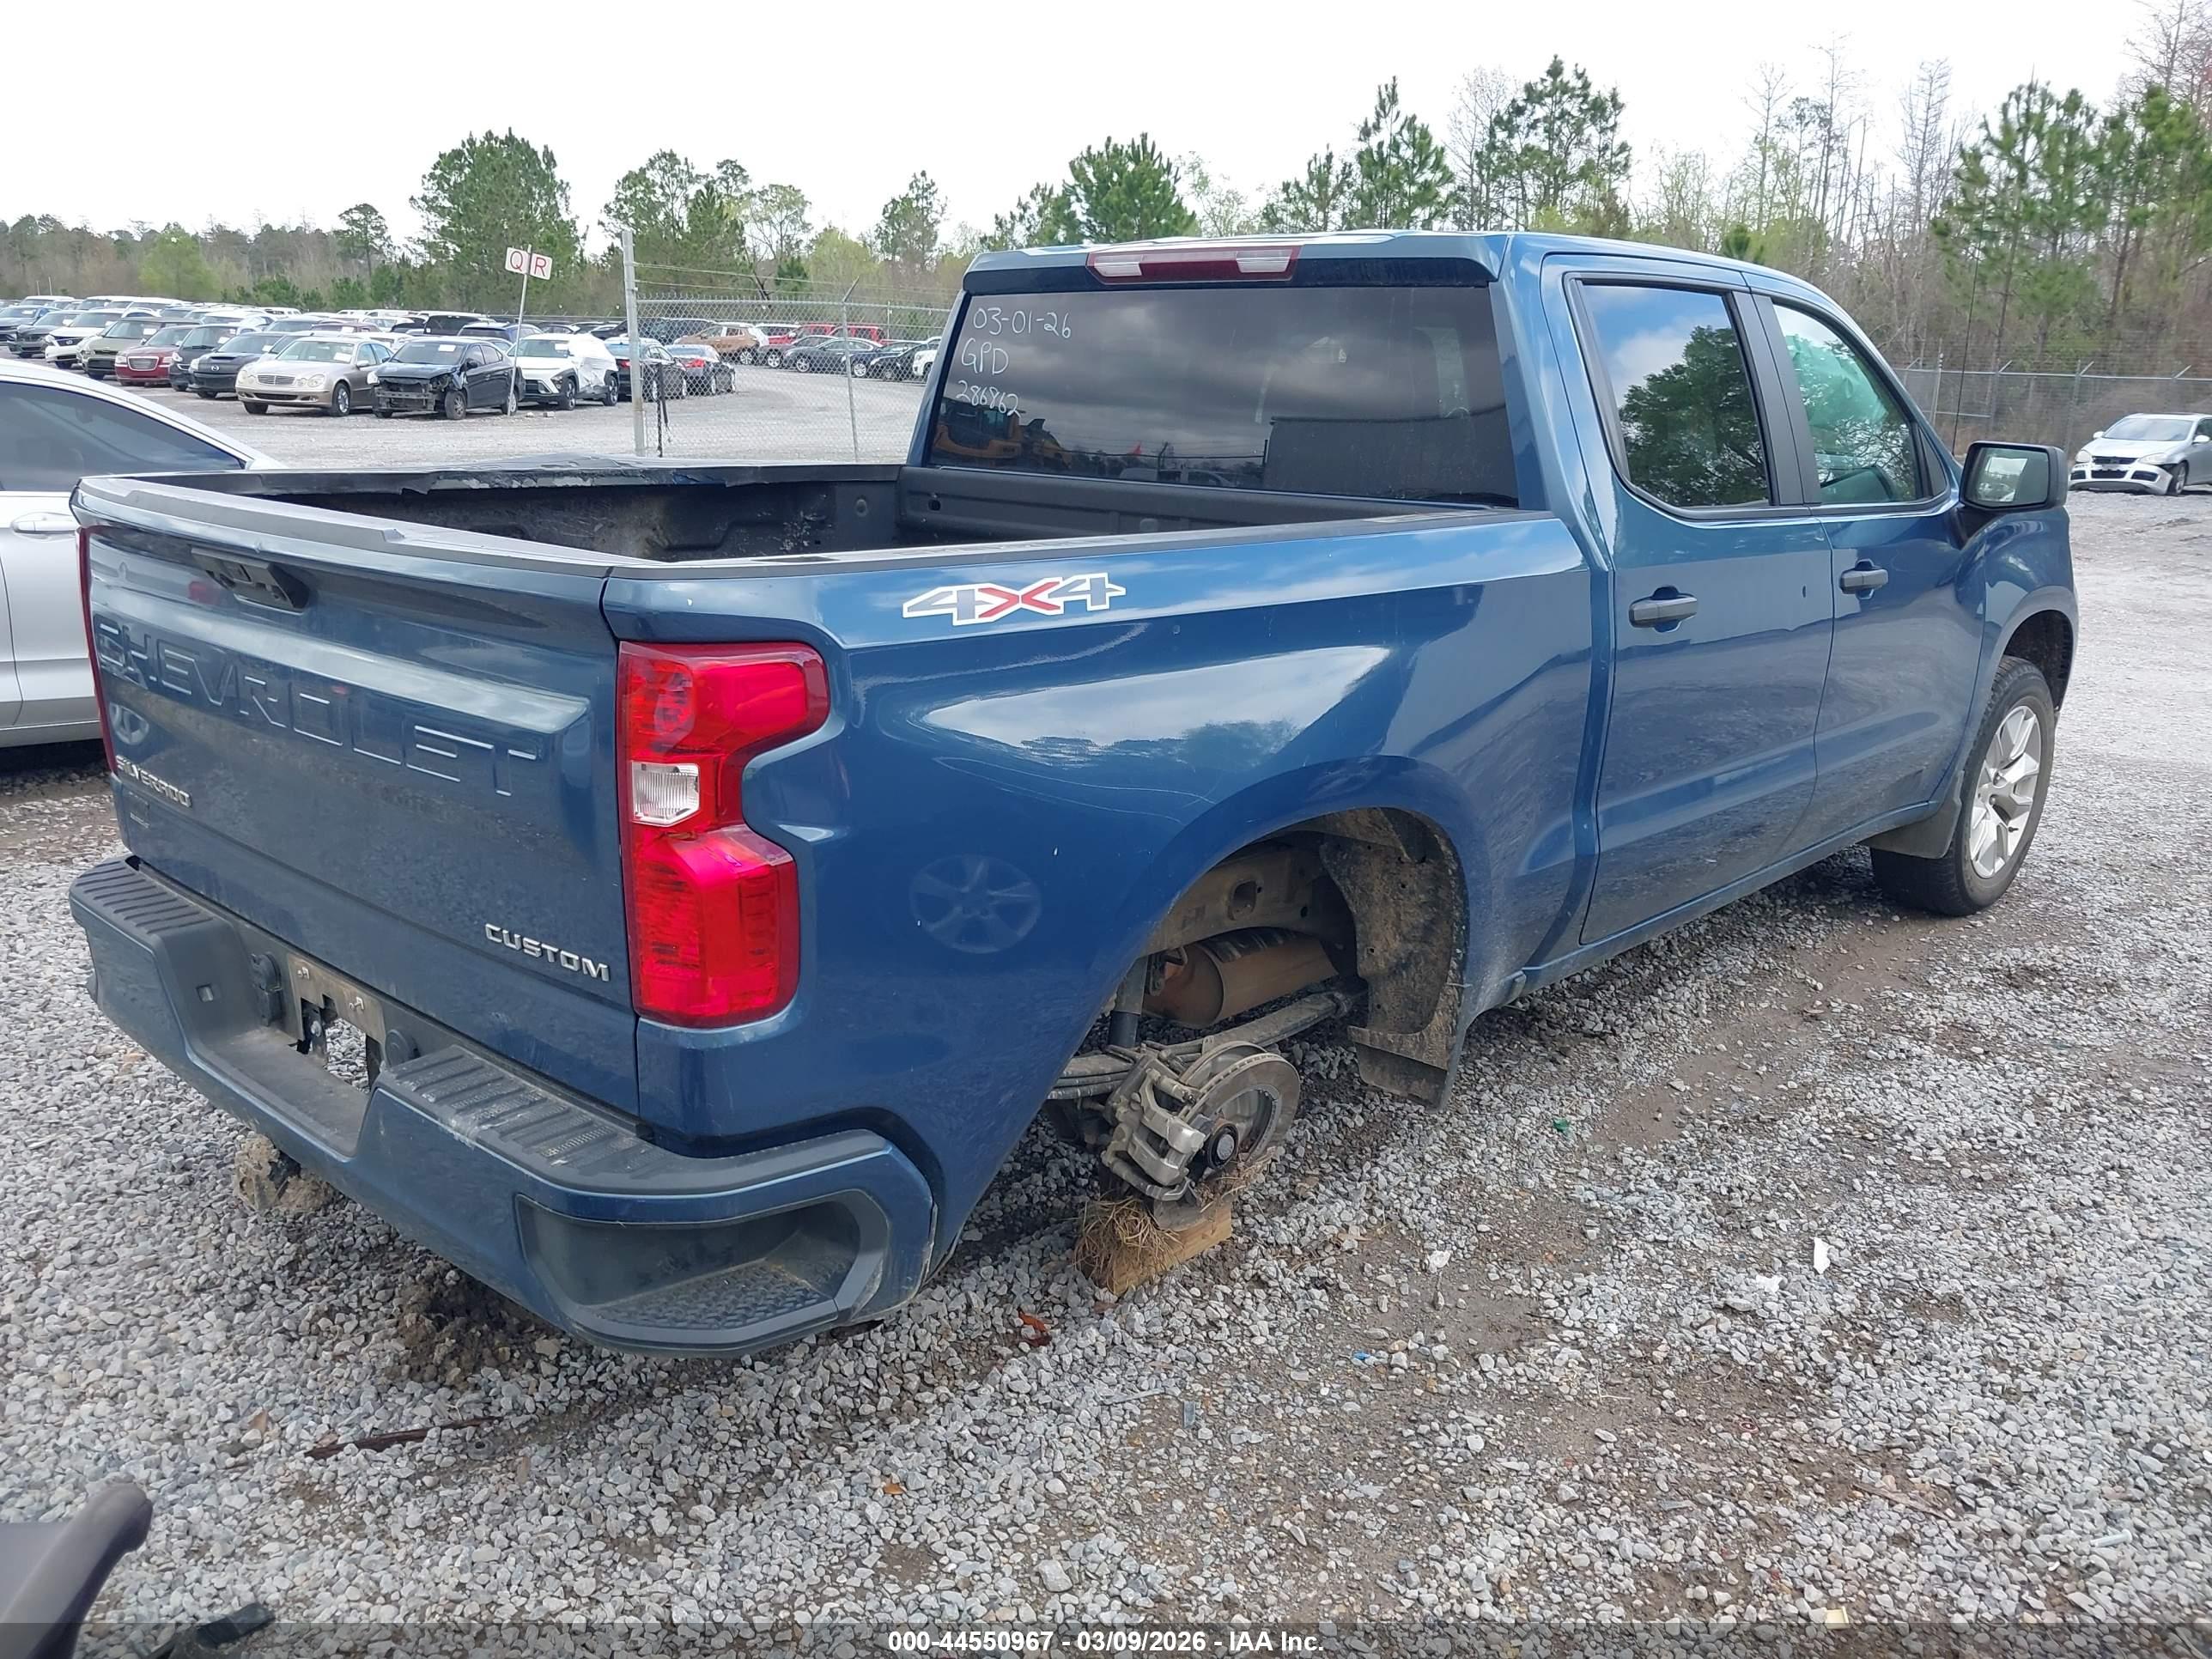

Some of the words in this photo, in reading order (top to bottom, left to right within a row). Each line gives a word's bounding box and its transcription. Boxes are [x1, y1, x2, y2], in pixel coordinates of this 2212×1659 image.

[509, 251, 522, 271] Q
[534, 257, 547, 276] R
[973, 307, 1072, 338] 03-01-26
[961, 337, 1009, 375] GPD
[956, 380, 1022, 418] 286862
[94, 613, 544, 796] CHEVROLET
[116, 755, 193, 809] SILVERADO
[485, 923, 611, 982] CUSTOM
